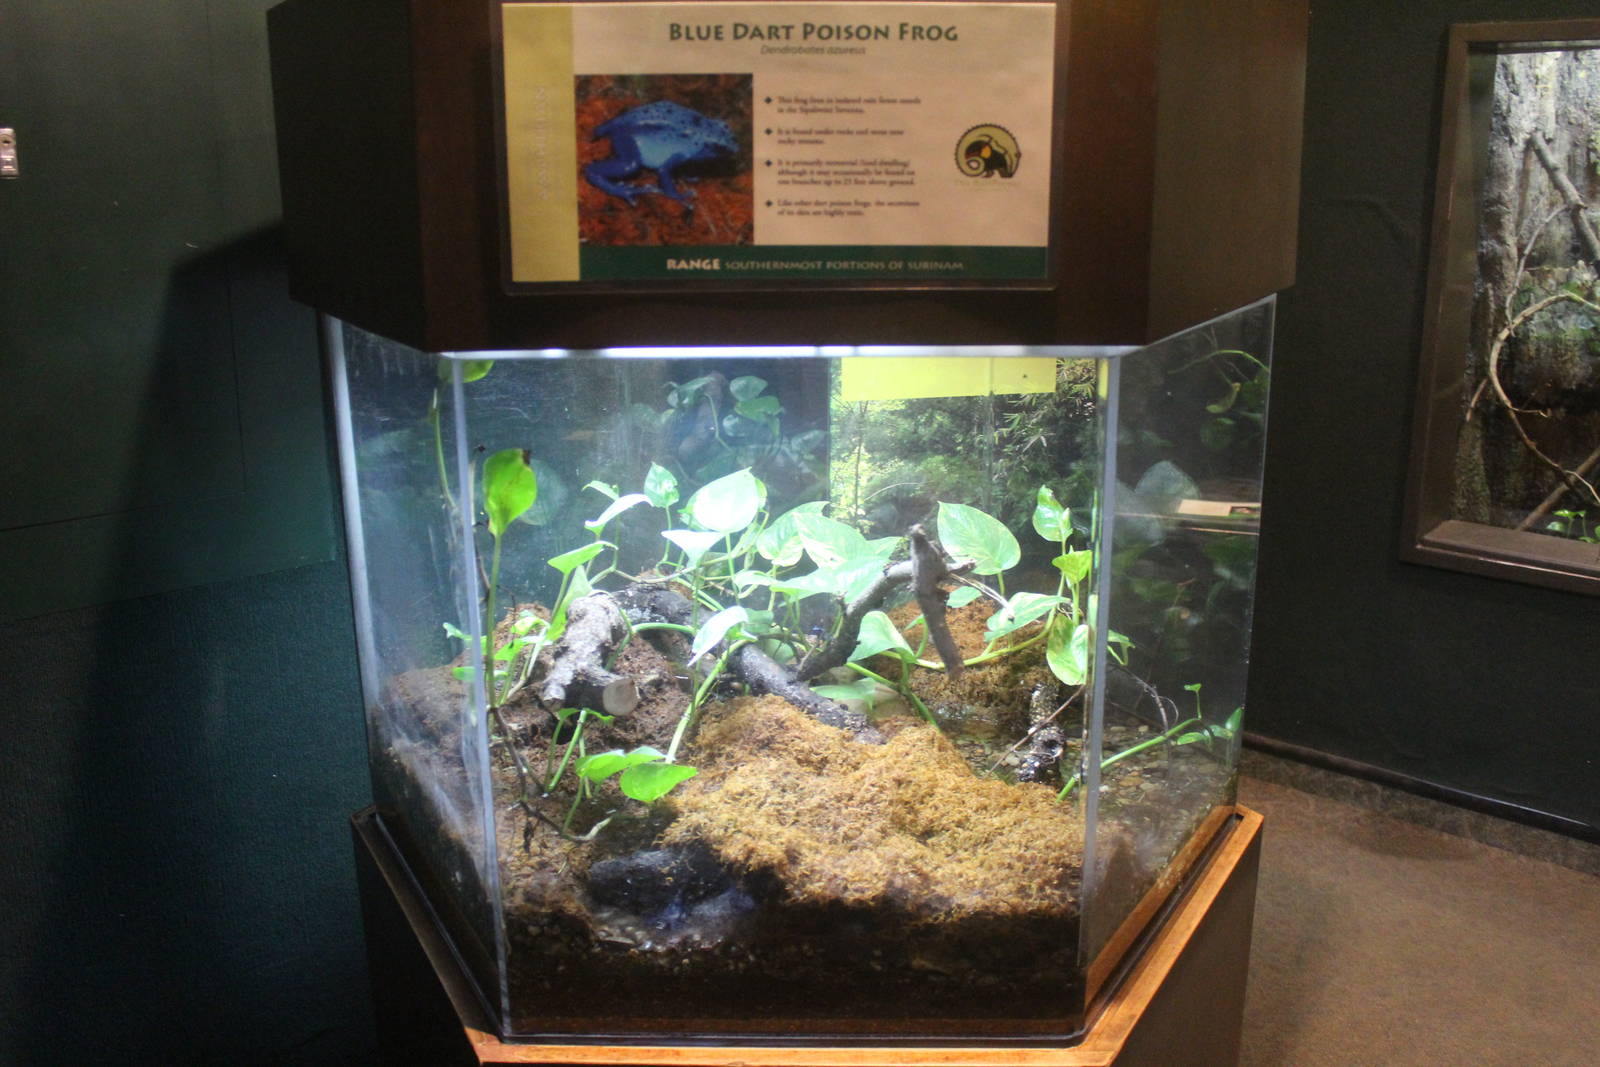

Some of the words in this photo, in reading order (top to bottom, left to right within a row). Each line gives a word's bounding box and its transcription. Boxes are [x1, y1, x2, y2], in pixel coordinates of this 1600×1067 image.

[670, 23, 724, 40] BLUE
[733, 23, 794, 40] DART
[802, 23, 889, 40] POISON
[898, 23, 958, 40] FROG
[667, 259, 720, 270] RANGE
[888, 260, 903, 270] OF
